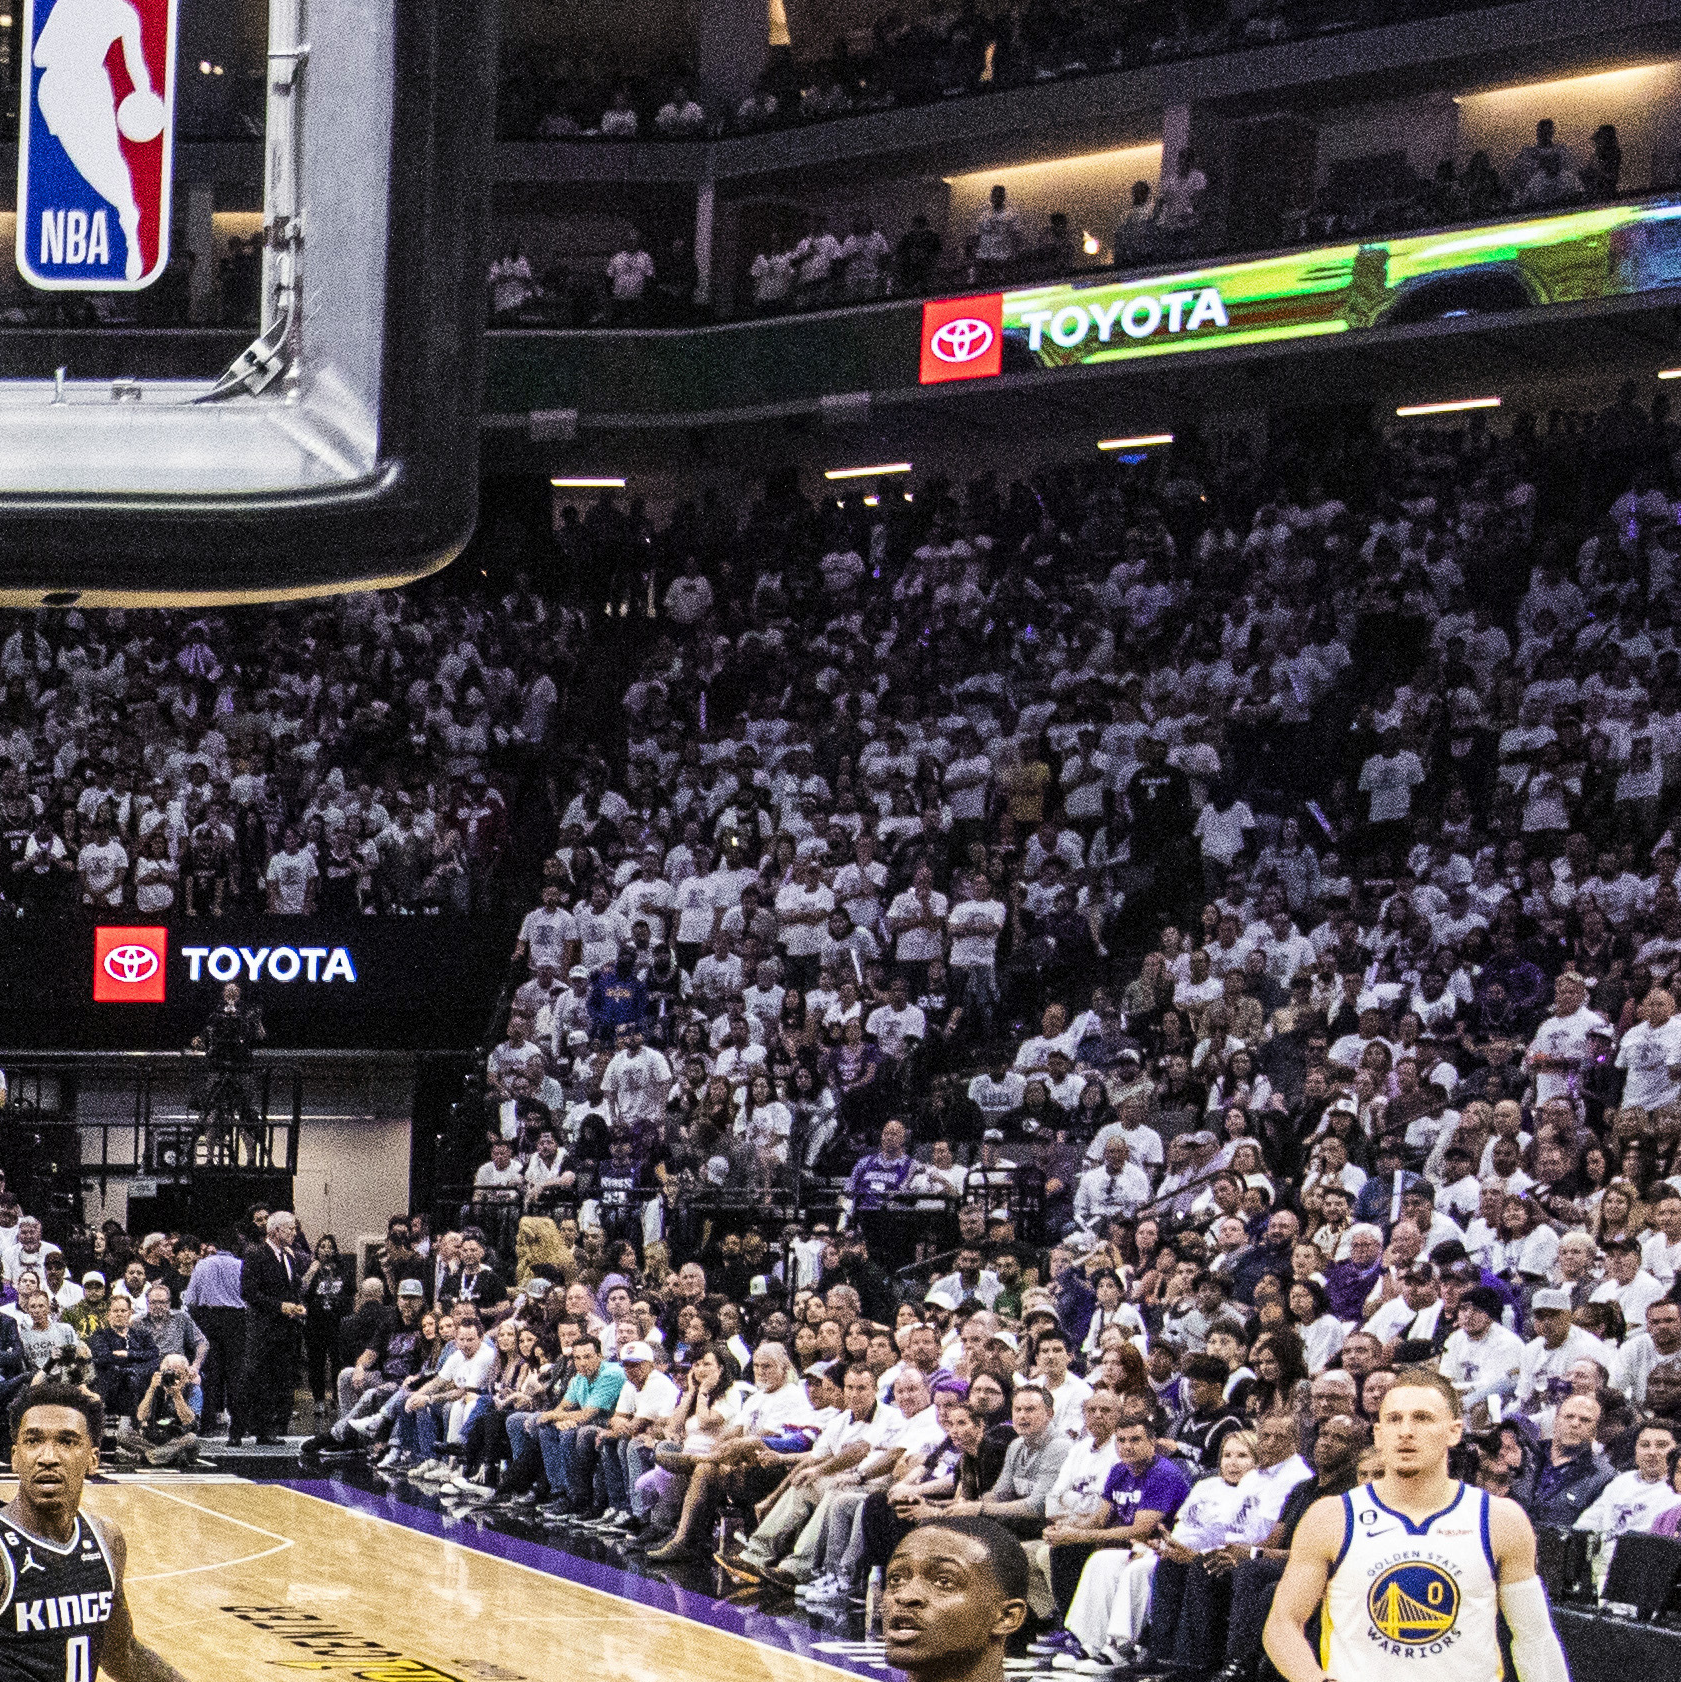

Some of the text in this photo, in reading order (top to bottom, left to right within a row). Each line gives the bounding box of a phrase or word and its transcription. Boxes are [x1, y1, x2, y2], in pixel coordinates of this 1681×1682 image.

[40, 209, 109, 265] NBA
[1022, 286, 1229, 352] TOYOTA
[182, 946, 355, 982] TOYOTA
[1367, 1550, 1463, 1577] GOLDEN STATE
[16, 1591, 112, 1631] KINGS
[1429, 1581, 1444, 1605] 0
[1367, 1625, 1462, 1659] WARRIORS
